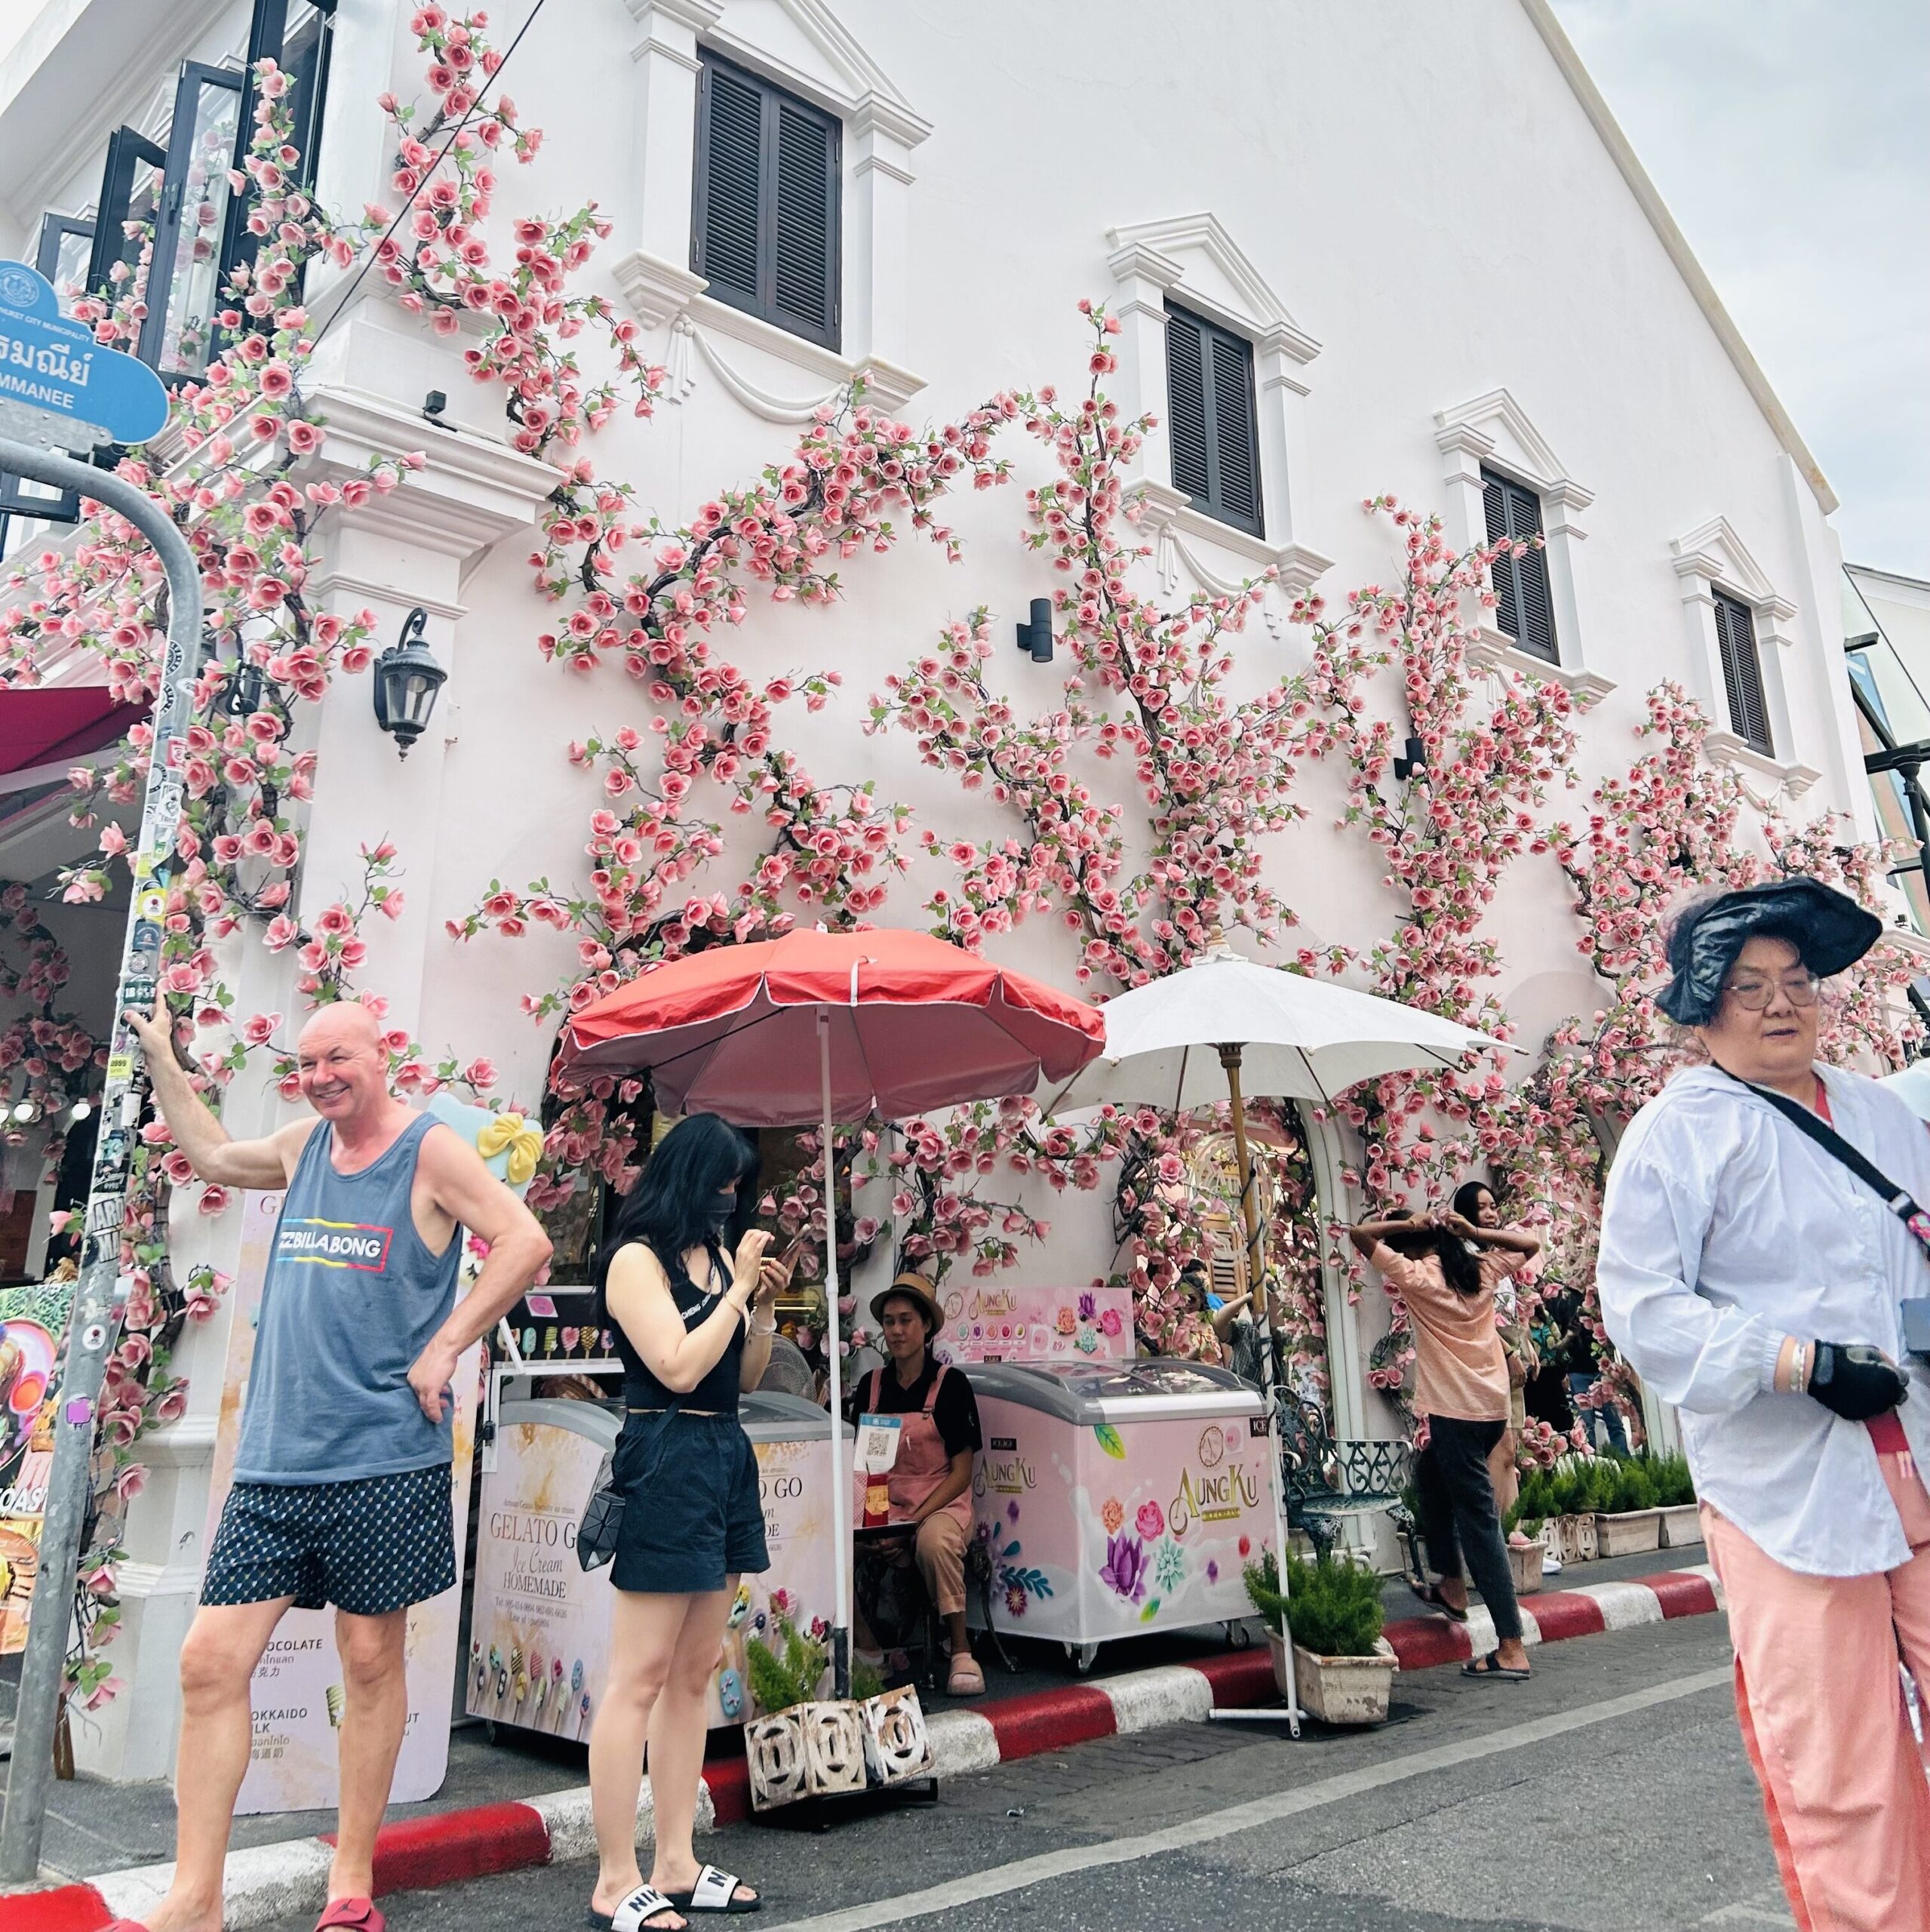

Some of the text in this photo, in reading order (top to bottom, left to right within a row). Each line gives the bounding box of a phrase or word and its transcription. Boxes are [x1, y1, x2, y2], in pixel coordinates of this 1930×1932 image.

[25, 315, 42, 327] CITY
[43, 321, 90, 343] MUNICIPALITY
[293, 1231, 381, 1258] BILLABONG
[0, 1487, 49, 1513] OAS
[774, 1477, 803, 1499] GO
[490, 1512, 576, 1549] GELATO G
[511, 1545, 563, 1574] Ice Cream
[503, 1572, 567, 1598] HOMEMADE
[266, 1638, 323, 1652] OCOLATE
[251, 1708, 308, 1721] OKKAIDO
[253, 1722, 270, 1734] LK
[707, 1867, 730, 1887] NI
[628, 1889, 662, 1913] NIK
